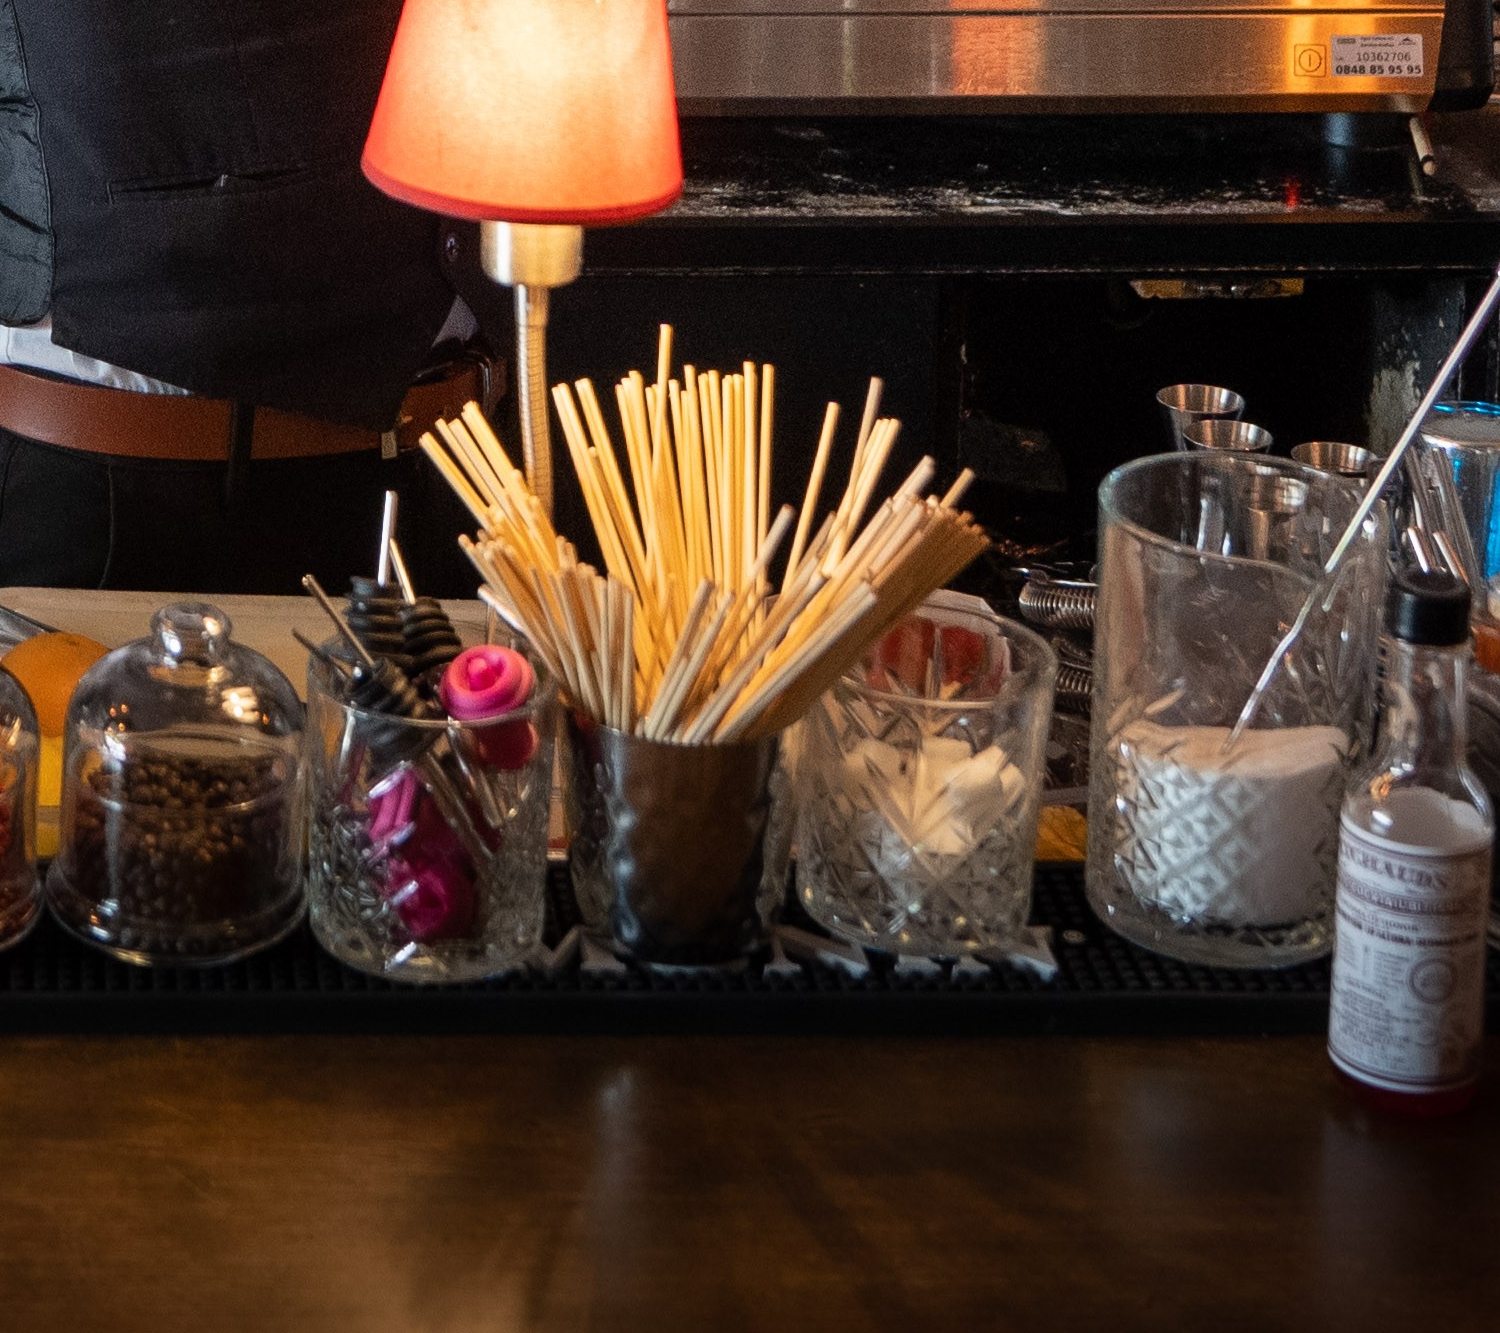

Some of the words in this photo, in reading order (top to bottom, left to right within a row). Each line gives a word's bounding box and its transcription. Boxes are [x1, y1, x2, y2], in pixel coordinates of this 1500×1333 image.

[1335, 64, 1366, 75] 0848
[1369, 64, 1385, 75] 85
[1387, 64, 1403, 75] 95
[1406, 64, 1422, 75] 95
